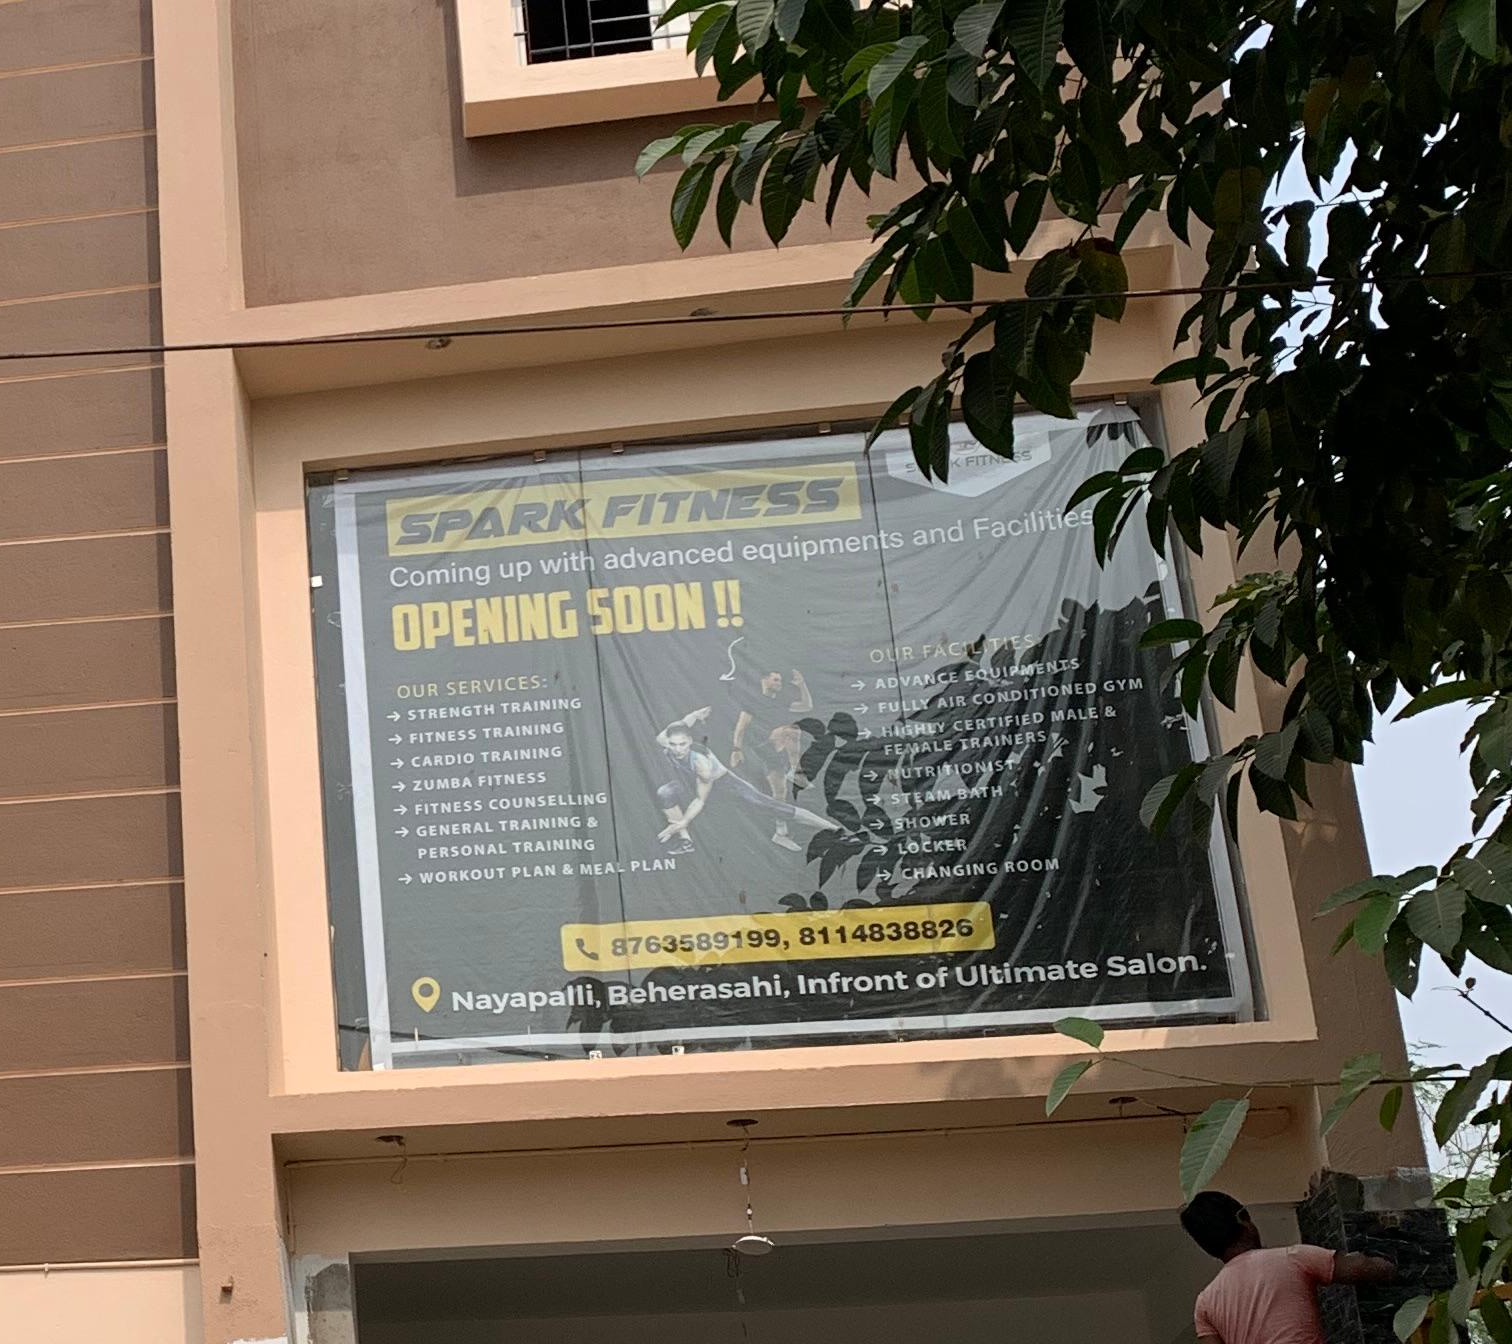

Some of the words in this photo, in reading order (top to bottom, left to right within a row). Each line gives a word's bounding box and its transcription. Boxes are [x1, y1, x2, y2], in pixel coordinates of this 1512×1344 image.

[395, 498, 591, 546] SPARK
[602, 477, 845, 529] FITNESS
[389, 562, 490, 588] Coming
[499, 560, 533, 583] up
[539, 551, 595, 575] with
[603, 540, 734, 570] advanced
[742, 529, 904, 565] equipments
[912, 521, 964, 545] and
[973, 508, 1094, 540] Facilities
[391, 590, 579, 651] OPENING
[586, 581, 706, 636] SOON
[712, 579, 744, 628] !!
[869, 645, 920, 663] OUR
[875, 672, 959, 689] ADVANCE
[965, 658, 1081, 682] EQUIPMENTS
[396, 683, 439, 699] OUR
[446, 675, 548, 696] SERVICES:
[878, 697, 930, 713] FULLY
[937, 692, 967, 707] AIR
[972, 682, 1097, 706] CONDITIONED
[1104, 677, 1144, 693] GYM
[407, 704, 495, 721] STRENGTH
[500, 697, 582, 714] TRAINING
[409, 728, 477, 744] FITNESS
[482, 722, 565, 739] TRAINING
[881, 721, 946, 738] HIGHLY
[953, 711, 1044, 733] CERTIFIED
[1050, 707, 1098, 723] MALE
[1104, 706, 1117, 718] &
[884, 739, 953, 756] FEMALE
[959, 730, 1047, 751] TRAINERS
[411, 753, 475, 768] CARDIO
[480, 746, 563, 763] TRAINING
[412, 776, 473, 791] ZUMBA
[478, 772, 547, 787] FITNESS
[887, 759, 1015, 781] NUTRITIONIST
[414, 799, 483, 815] FITNESS
[489, 792, 608, 811] COUNSELLING
[891, 789, 951, 805] STEAM
[957, 785, 1003, 800] BATH
[416, 821, 494, 837] GENERAL
[498, 816, 581, 832] TRAINING
[586, 816, 599, 828] &
[894, 813, 971, 830] SHOWER
[418, 843, 507, 859] PERSONAL
[512, 838, 595, 854] TRAINING
[898, 838, 968, 855] LOCKER
[419, 867, 506, 884] WORKOUT
[511, 864, 556, 879] PLAN
[561, 864, 574, 876] &
[579, 862, 625, 876] MEAL
[631, 858, 677, 873] PLAN
[901, 862, 998, 880] CHANGING
[1004, 858, 1060, 873] ROOM
[611, 928, 790, 957] 8763589199,
[798, 918, 974, 947] 8114838826
[451, 984, 600, 1014] Nayapalli,
[608, 974, 791, 1007] Beherasahi,
[798, 970, 908, 996] Infront
[915, 966, 949, 989] of
[954, 958, 1099, 988] Ultimate
[1106, 952, 1208, 978] Salon.
